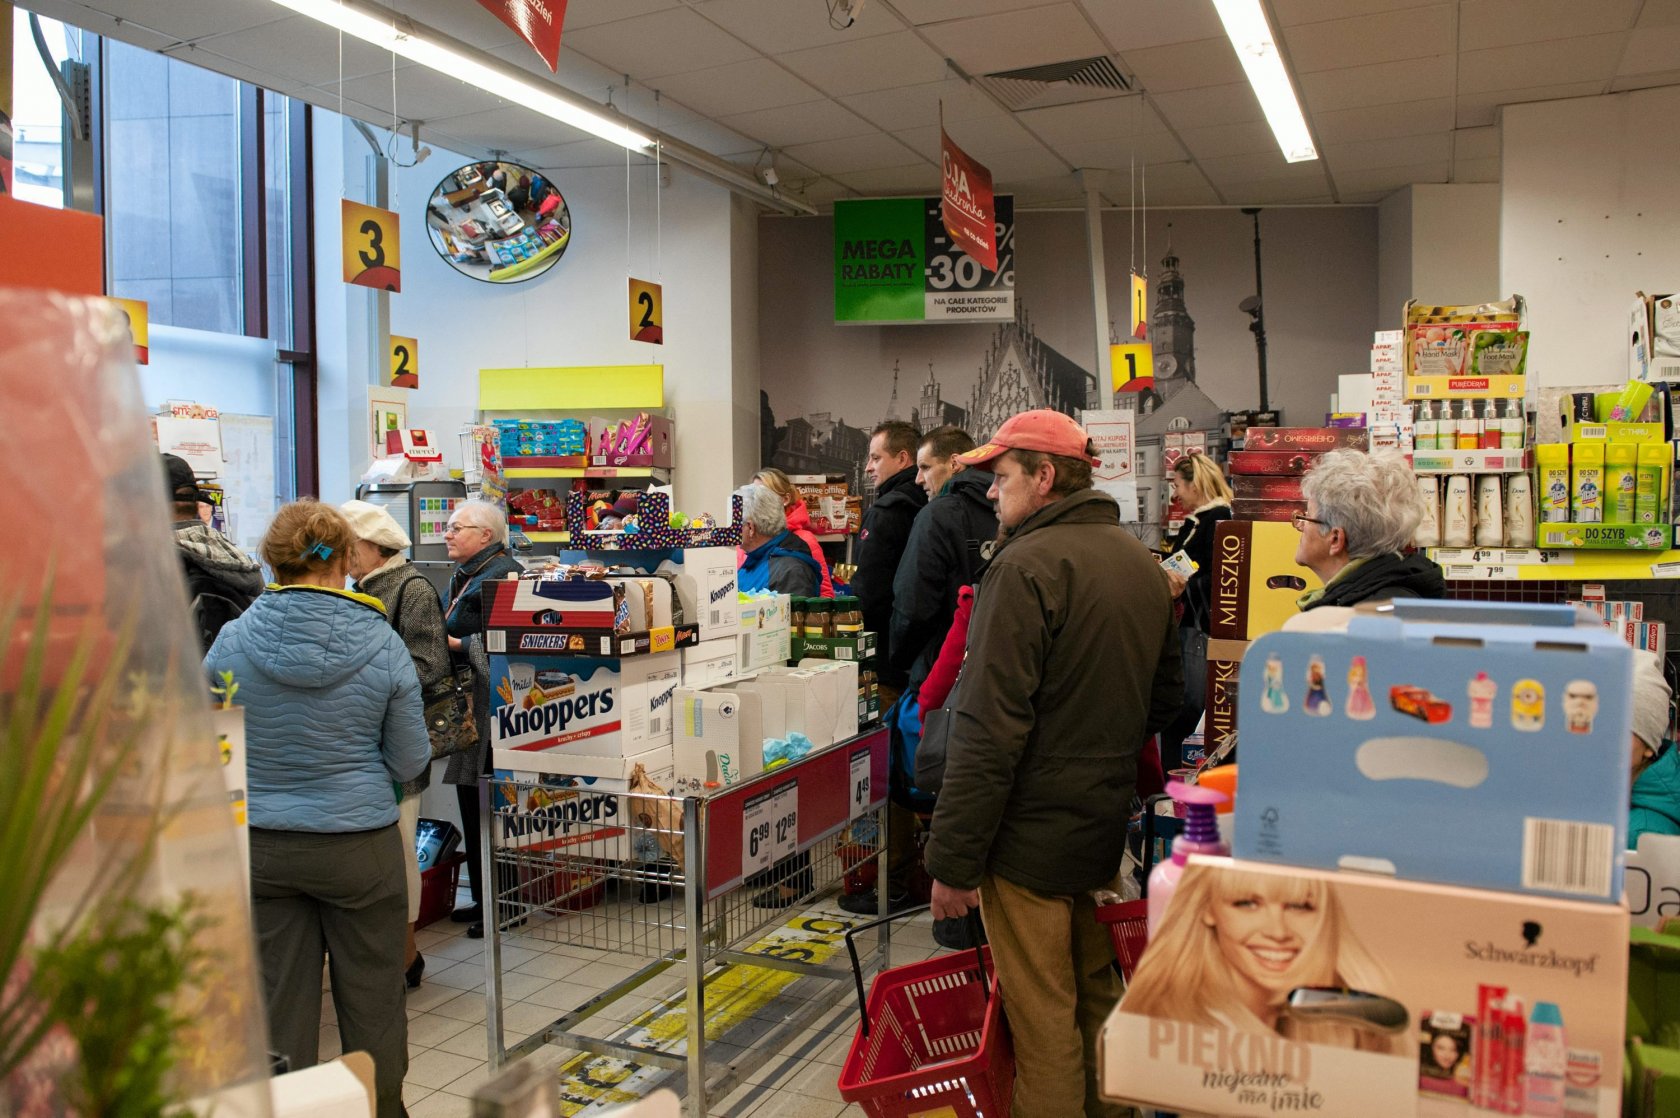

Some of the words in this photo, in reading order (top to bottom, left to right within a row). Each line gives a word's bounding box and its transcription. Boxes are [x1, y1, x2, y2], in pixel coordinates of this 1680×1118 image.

[358, 219, 385, 268] 3
[842, 239, 917, 260] MEGA
[842, 263, 917, 280] RABATY
[967, 296, 1008, 304] KATEGORIE
[638, 291, 654, 328] 2
[946, 305, 996, 314] PRODUKTÓW
[393, 344, 410, 375] 2
[1440, 350, 1458, 358] Mask
[1124, 353, 1136, 380] 1
[1619, 428, 1626, 436] C
[1627, 428, 1648, 436] THRU
[409, 447, 435, 455] merci
[587, 491, 611, 500] Mars
[619, 492, 639, 500] Mar
[1585, 528, 1599, 539] DO
[1601, 528, 1625, 539] SZYB
[1219, 535, 1241, 625] MIESZKO
[710, 580, 735, 605] Knoppers
[521, 634, 568, 649] SNICKERS
[655, 633, 671, 647] Twix
[498, 687, 614, 740] Knoppers
[500, 794, 619, 840] Knoppers
[1465, 940, 1600, 978] Schwarzkopf
